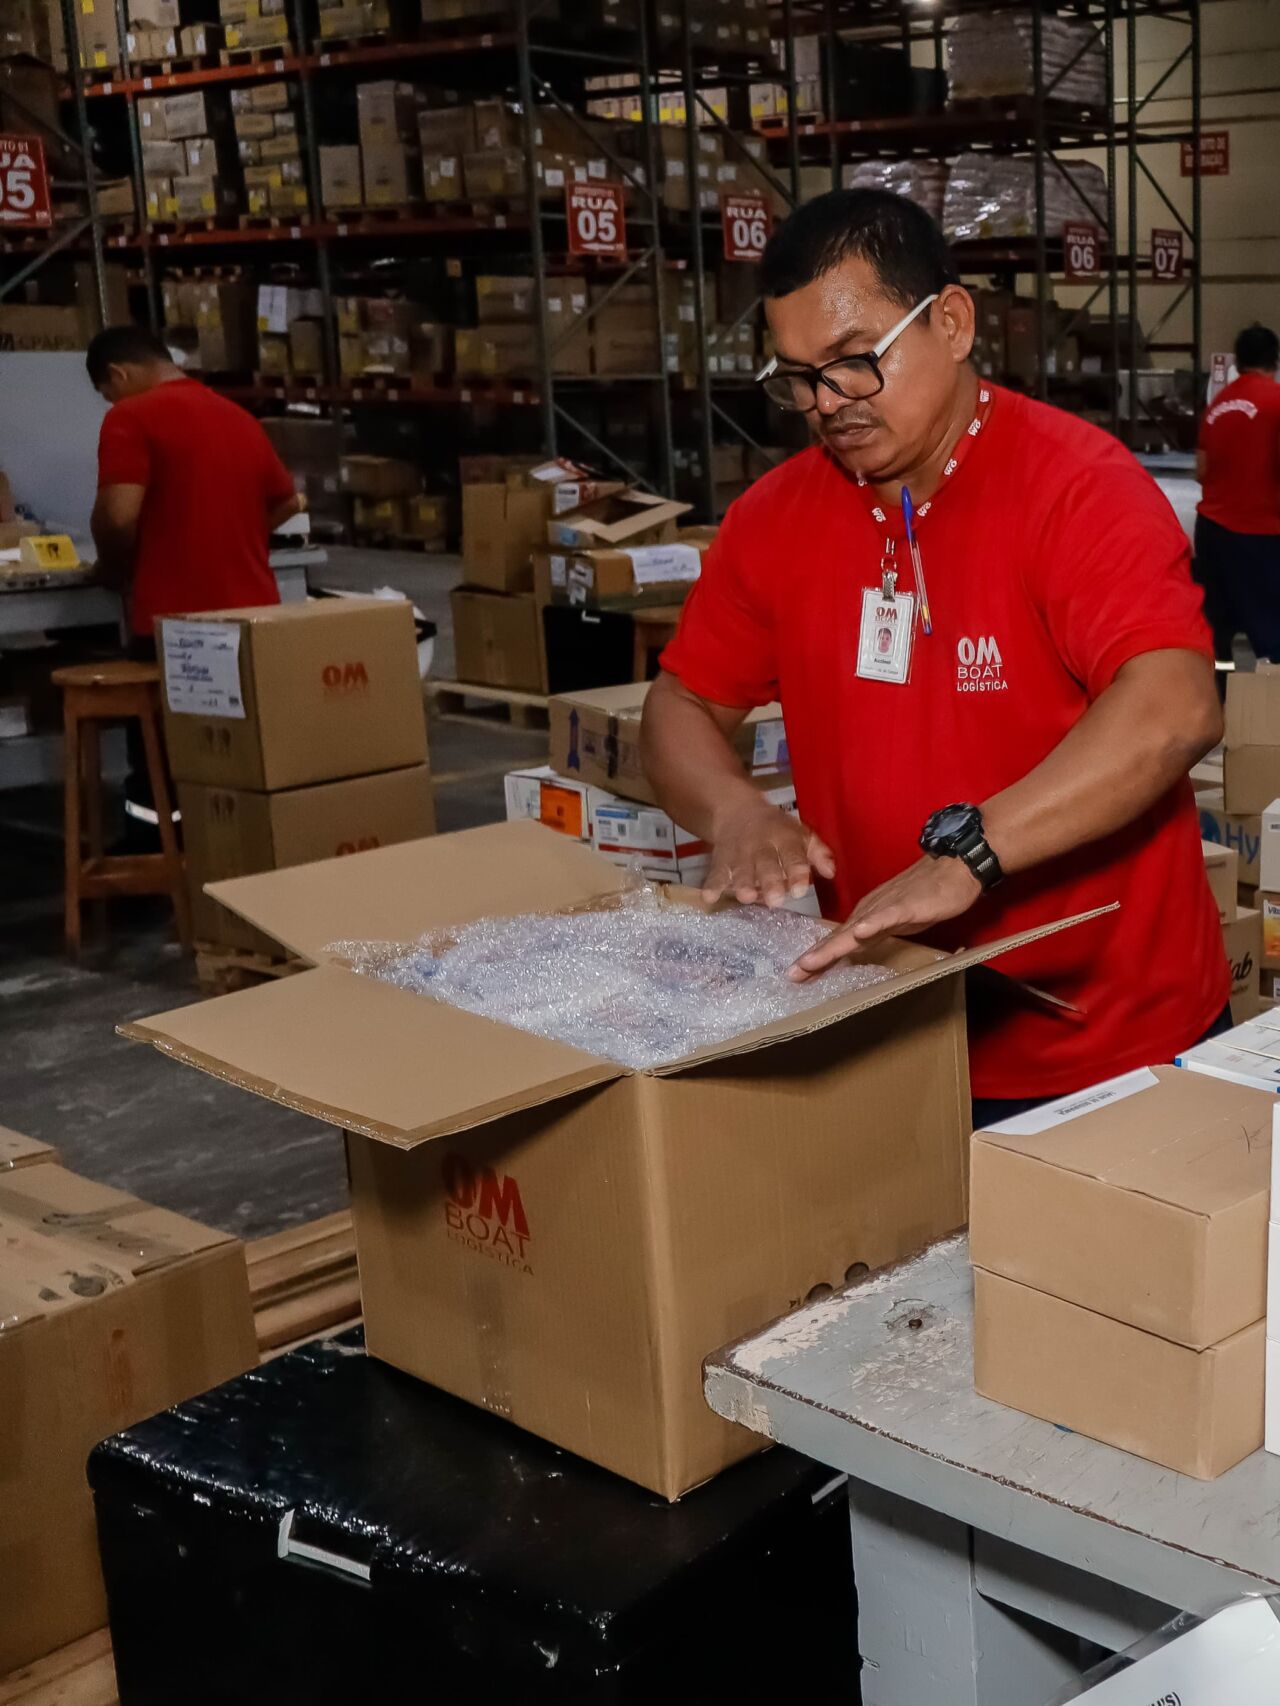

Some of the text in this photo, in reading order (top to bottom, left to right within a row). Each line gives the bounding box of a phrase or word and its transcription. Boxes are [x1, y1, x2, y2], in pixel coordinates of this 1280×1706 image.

[0, 153, 36, 169] UA
[0, 170, 35, 209] 5
[571, 195, 618, 211] RUA
[726, 206, 767, 220] RUA
[577, 210, 617, 242] 05
[732, 219, 767, 249] 06
[1067, 234, 1096, 246] RUA
[1070, 245, 1095, 270] 06
[1155, 247, 1179, 272] 07
[876, 607, 898, 620] OM
[957, 635, 1003, 667] OM
[322, 662, 368, 688] OM
[957, 663, 1003, 680] BOAT
[957, 679, 1008, 693] LOGÍSTICA
[1225, 822, 1260, 864] Hy
[442, 1151, 530, 1237] OM
[445, 1200, 531, 1258] BOAT
